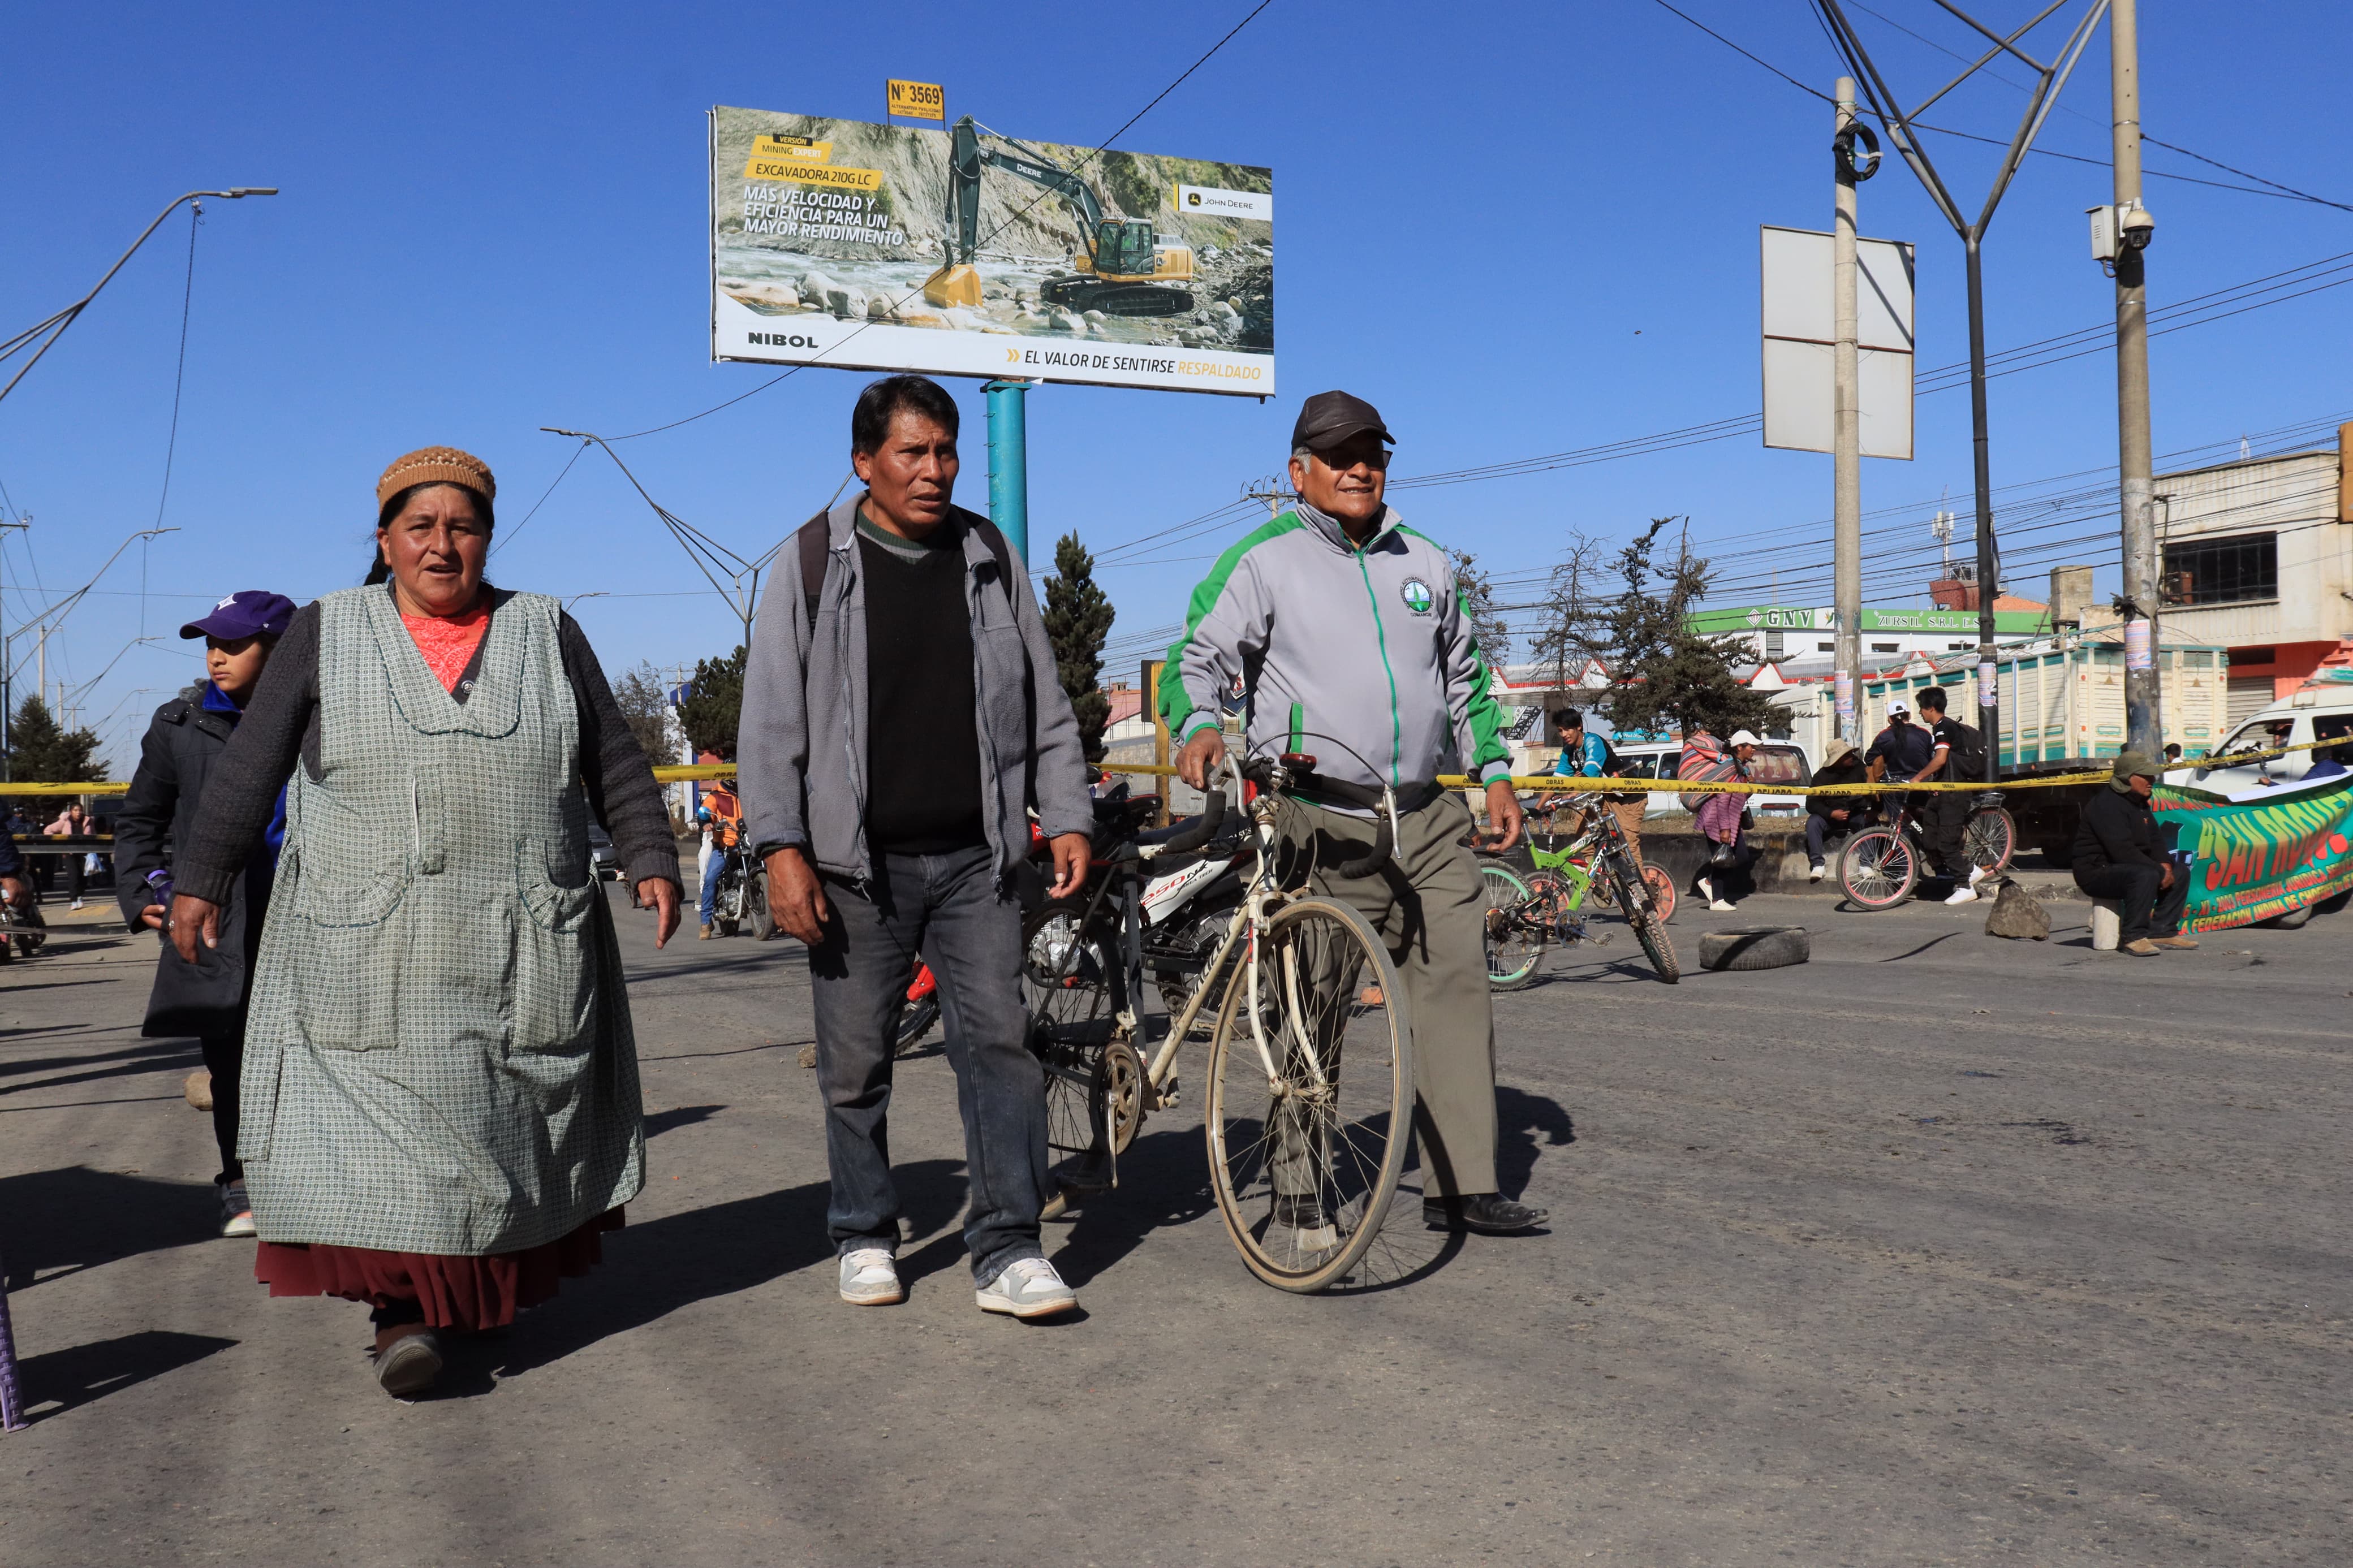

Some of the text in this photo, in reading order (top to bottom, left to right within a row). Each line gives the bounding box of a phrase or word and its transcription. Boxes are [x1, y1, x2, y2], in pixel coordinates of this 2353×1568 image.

[910, 85, 940, 105] 3569
[779, 136, 807, 145] VERSIÓN
[762, 145, 821, 158] MINING EXPERT
[756, 163, 872, 185] EXCAVADORA 210G LC
[1016, 163, 1042, 178] DEERE
[743, 184, 876, 211] MÁS VELOCIDAD Y
[1204, 197, 1253, 209] JOHN DEERE
[743, 202, 889, 228] EFICIENCIA PARA UN
[744, 218, 903, 245] MAYOR RENDIMIENTO
[748, 332, 820, 348] NIBOL
[1024, 350, 1262, 381] EL VALOR DE SENTIRSE RESPALDADO
[1911, 819, 1923, 834] SCO
[2191, 907, 2253, 934] FEDERACION
